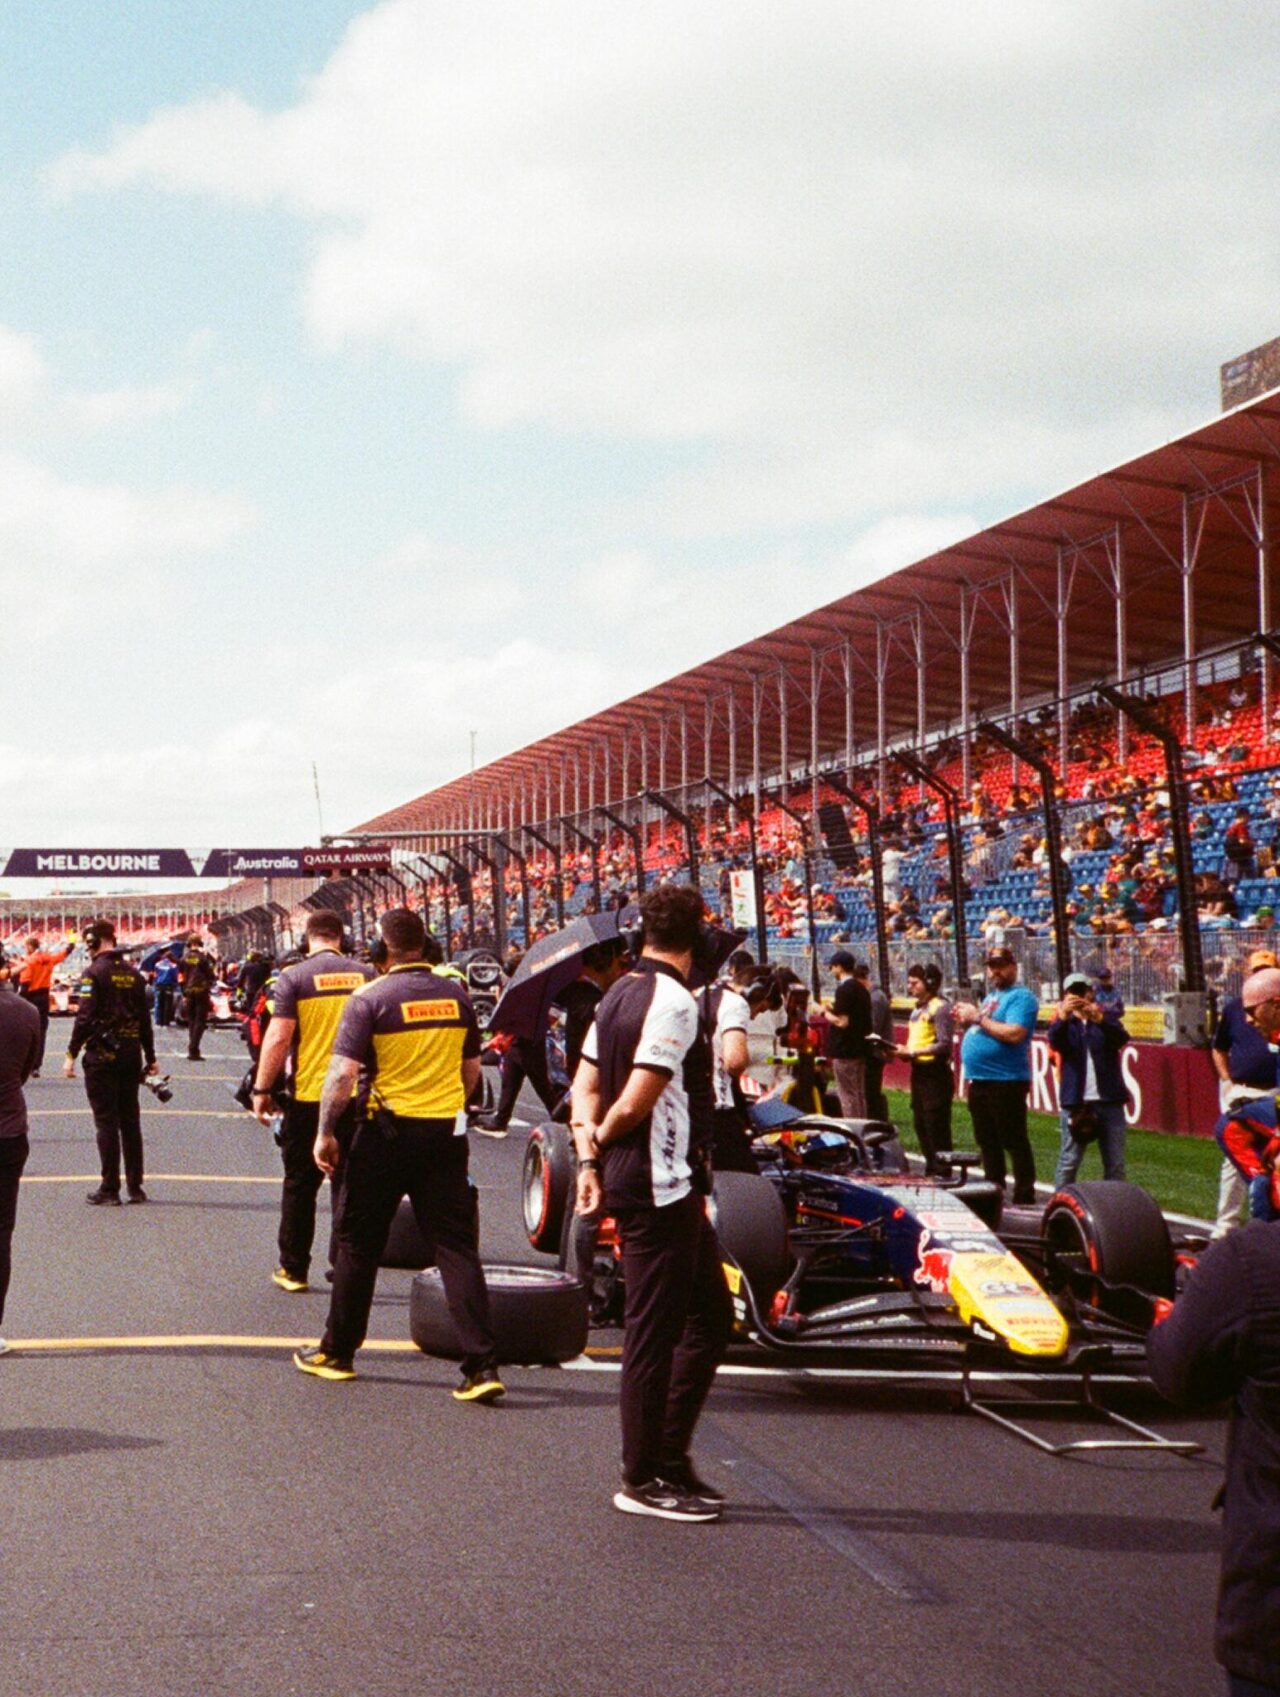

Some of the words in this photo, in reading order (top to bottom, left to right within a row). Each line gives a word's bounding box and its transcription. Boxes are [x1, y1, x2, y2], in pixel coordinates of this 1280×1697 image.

[37, 855, 160, 871] MELBOURNE
[235, 857, 298, 870] Australia
[304, 854, 342, 864] QATAR
[344, 852, 391, 863] AIRWAYS
